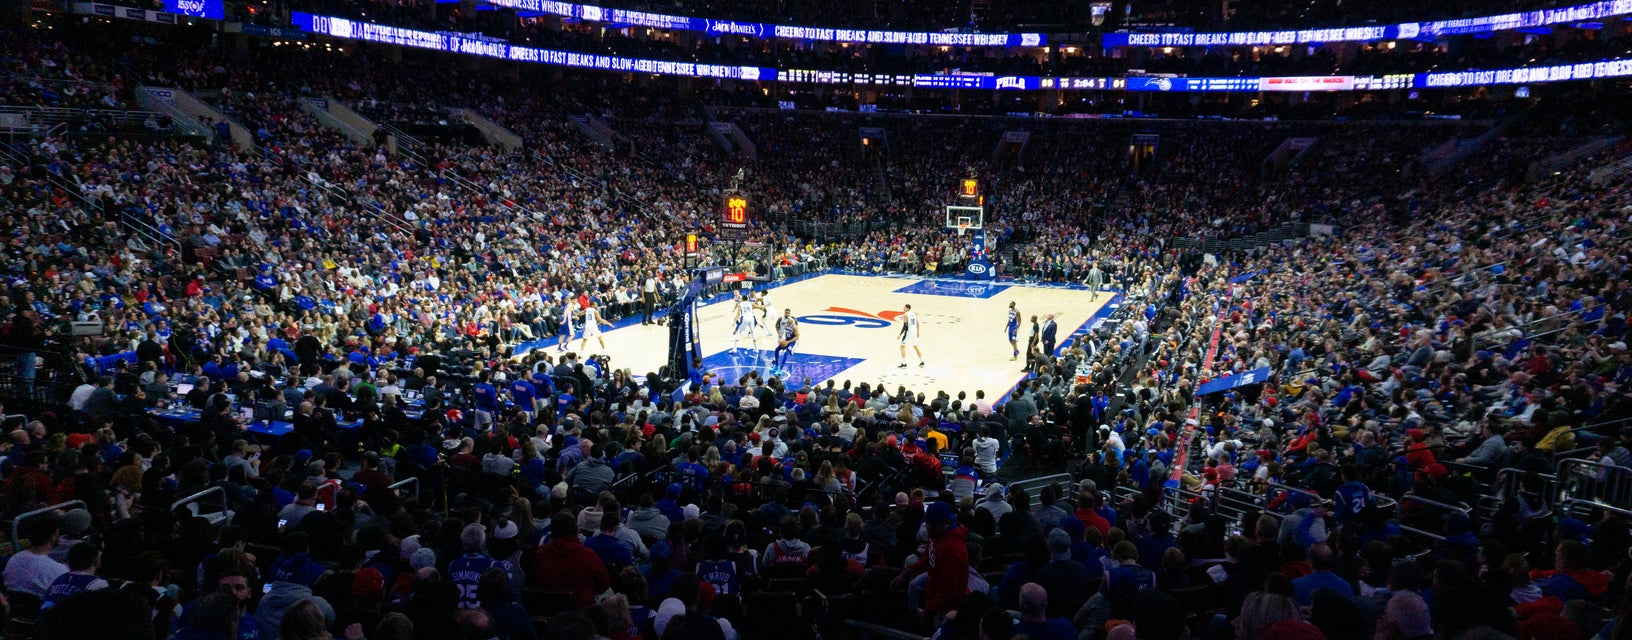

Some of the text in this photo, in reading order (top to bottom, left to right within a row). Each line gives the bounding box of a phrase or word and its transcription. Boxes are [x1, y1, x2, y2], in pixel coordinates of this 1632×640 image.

[541, 1, 573, 17] WHISKEY
[775, 25, 804, 39] CHEERS
[804, 27, 816, 40] TO
[816, 28, 834, 41] FAST
[835, 30, 866, 42] BREAKS
[866, 31, 883, 43] AND
[1128, 33, 1160, 45] CHEERS
[1161, 33, 1173, 45] TO
[1173, 33, 1194, 45] FAST
[1195, 33, 1227, 45] BREAKS
[540, 49, 549, 62] TO
[550, 51, 567, 65] FAST
[567, 53, 594, 67] BREAKS
[595, 55, 610, 69] AND
[995, 76, 1025, 90] PHILA
[1074, 79, 1095, 88] 2:04
[1427, 73, 1462, 86] CHEERS
[1462, 72, 1474, 85] TO
[1475, 70, 1495, 84] FAST
[731, 207, 743, 222] 10
[1351, 496, 1367, 514] 21
